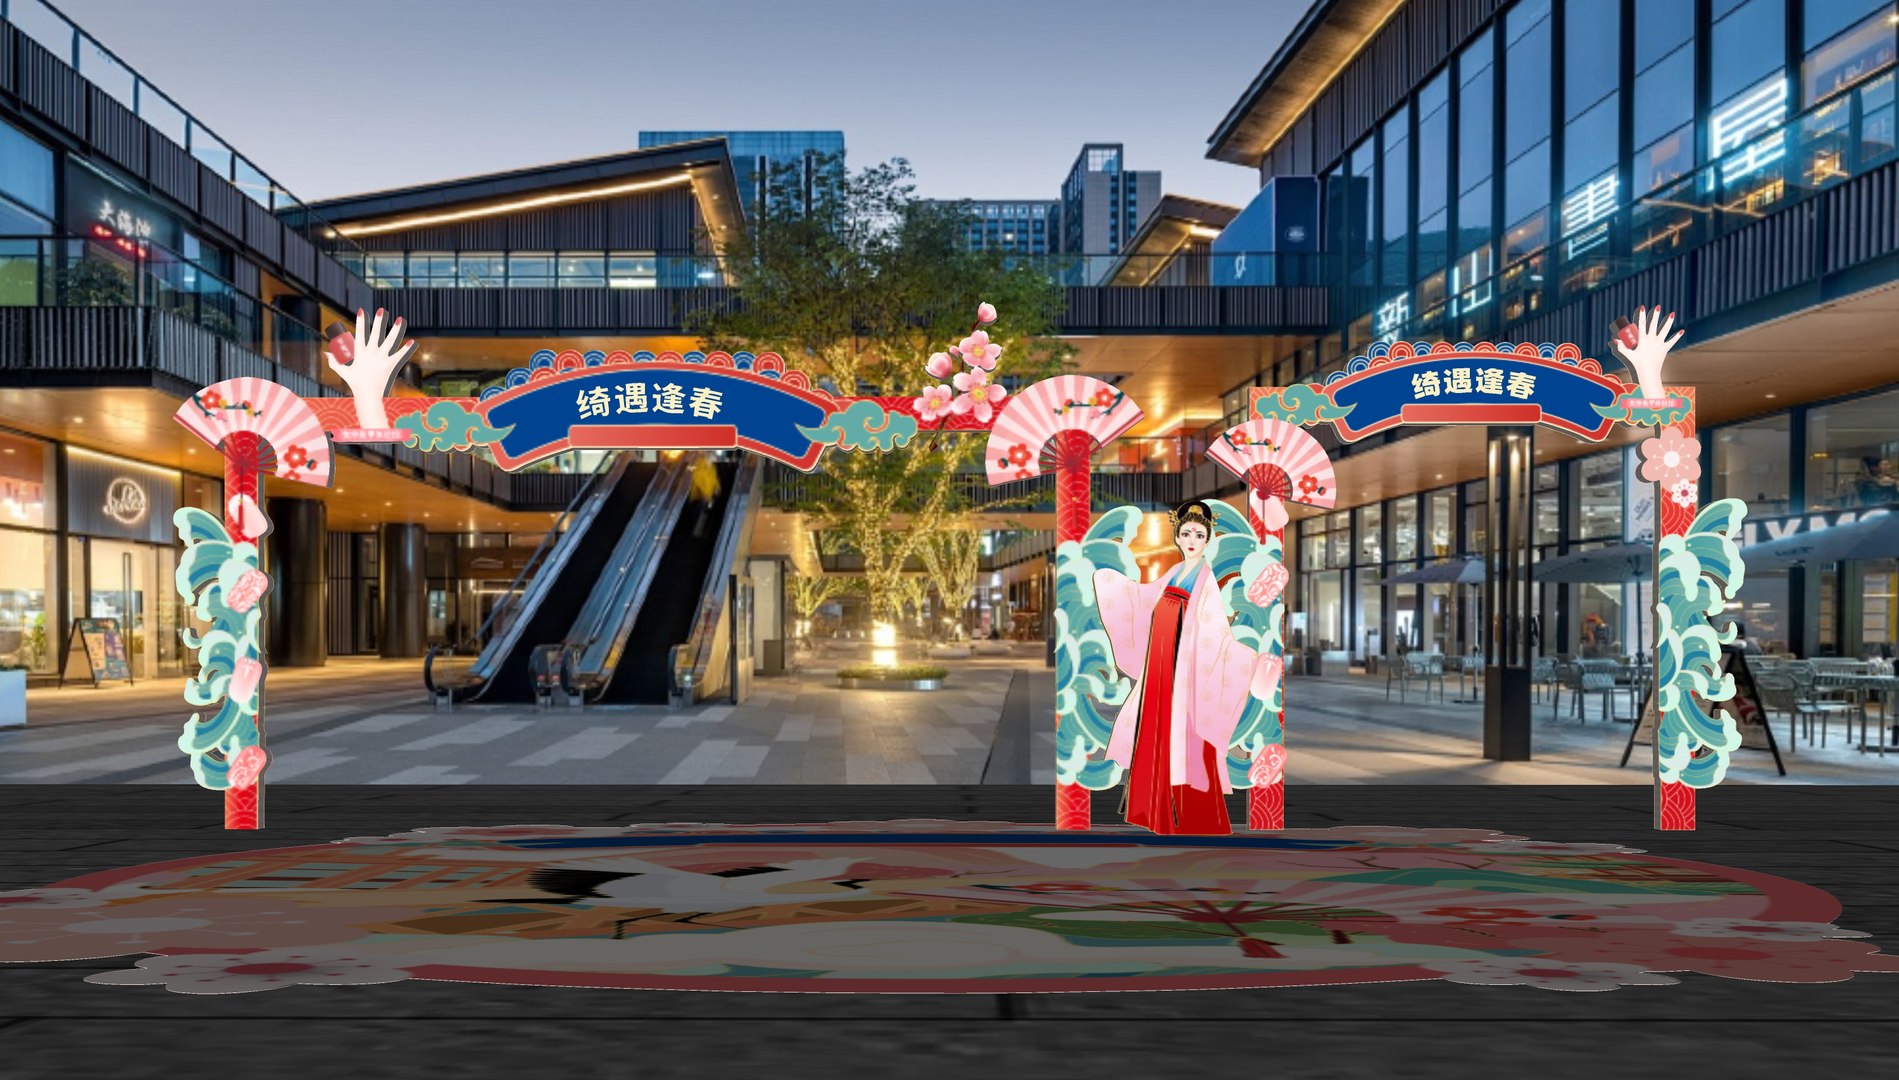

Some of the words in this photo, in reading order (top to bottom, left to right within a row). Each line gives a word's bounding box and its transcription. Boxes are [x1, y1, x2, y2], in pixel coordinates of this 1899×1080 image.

[576, 382, 724, 420] 绮遇逢春
[1411, 367, 1537, 400] 绮遇逢春
